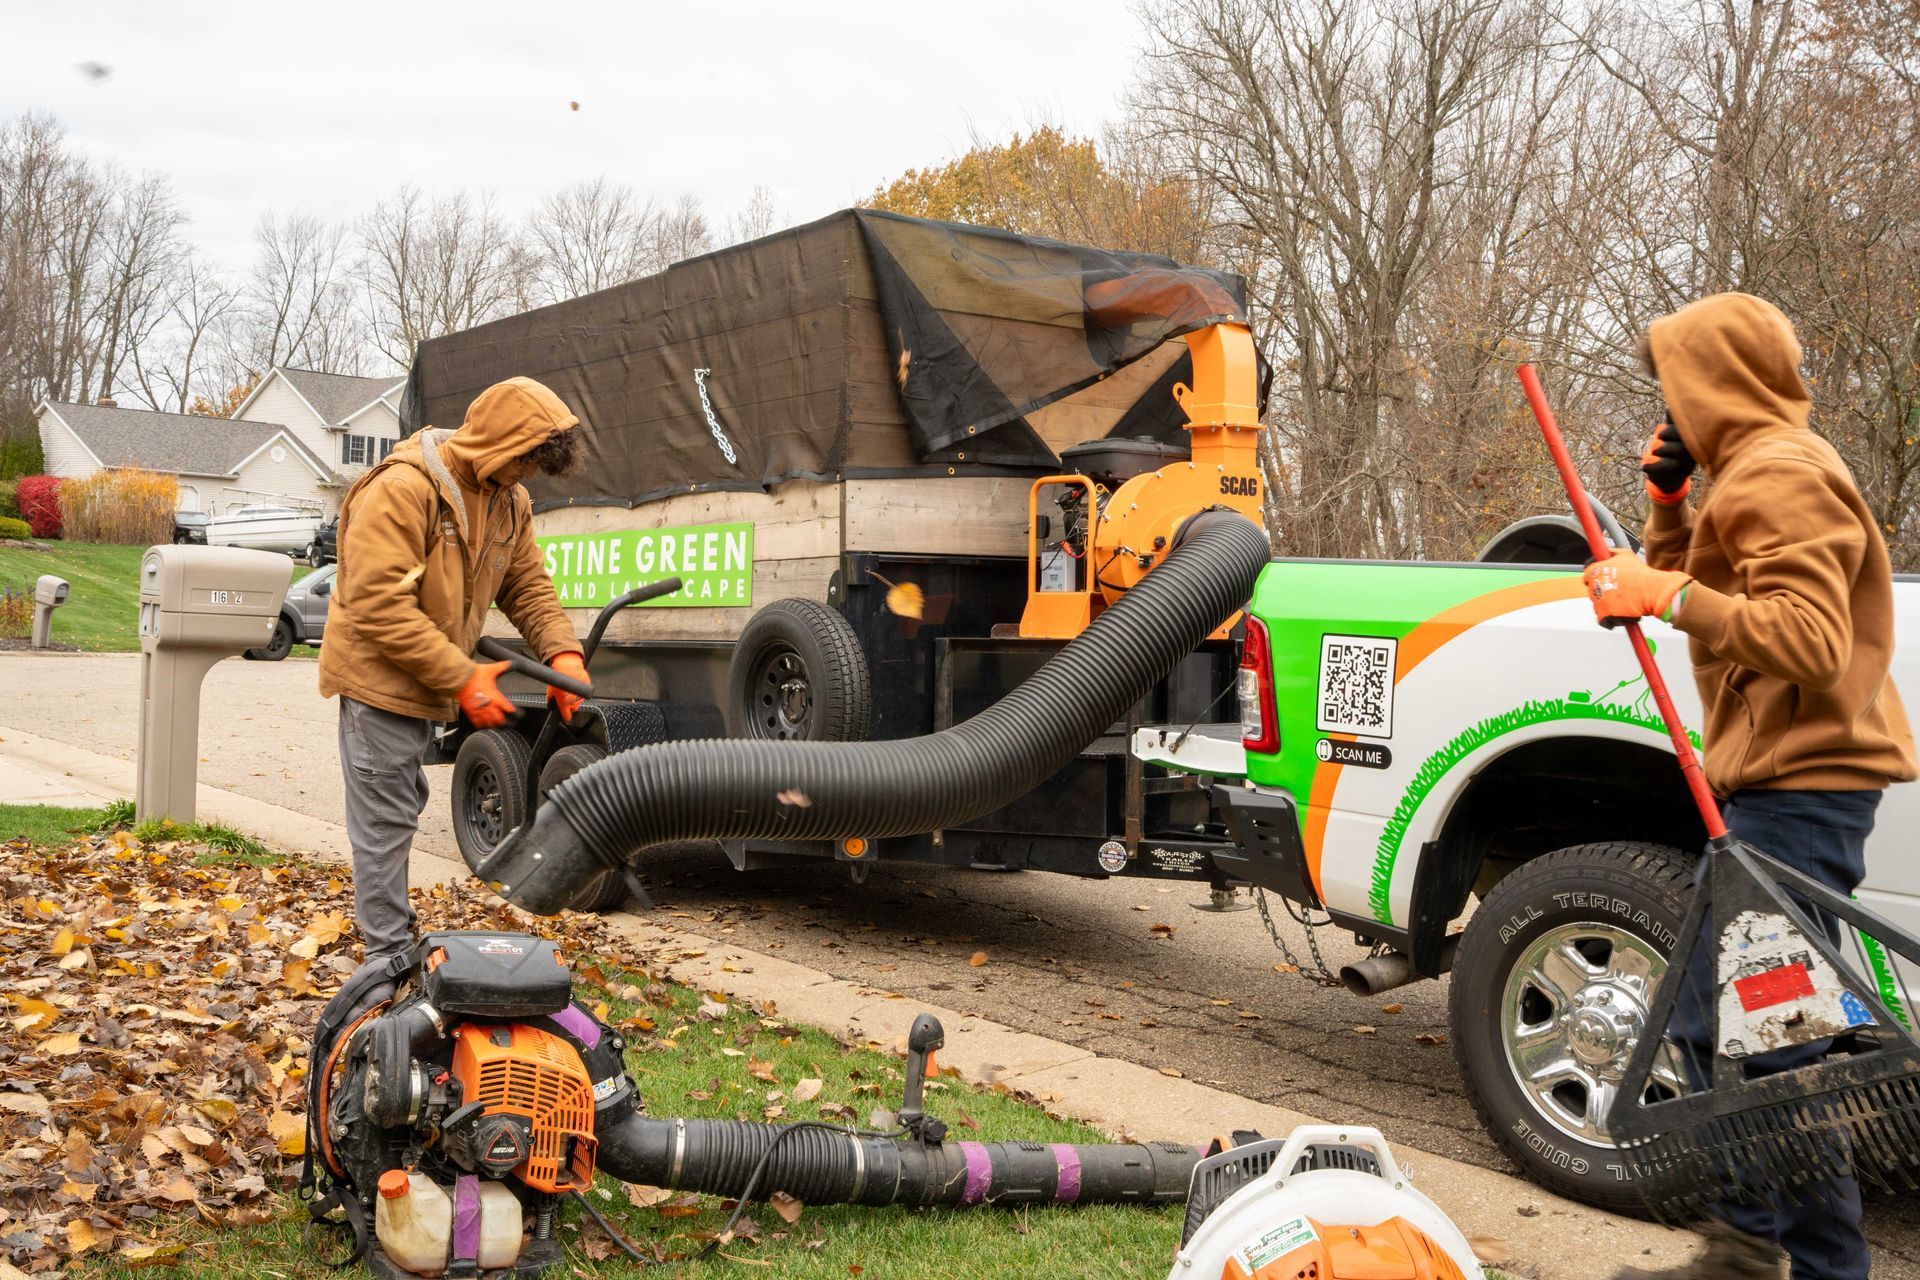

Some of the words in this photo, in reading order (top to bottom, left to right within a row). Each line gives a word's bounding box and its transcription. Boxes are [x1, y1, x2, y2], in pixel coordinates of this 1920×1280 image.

[1220, 476, 1257, 496] SCAG
[536, 538, 622, 577] STINE
[636, 531, 747, 573] GREEN
[560, 582, 596, 600] AND
[1336, 747, 1363, 762] SCAN
[1366, 751, 1382, 764] ME
[1499, 905, 1544, 945] ALL
[1553, 891, 1678, 951] TERRAIN
[1512, 1118, 1590, 1176] GUIDE
